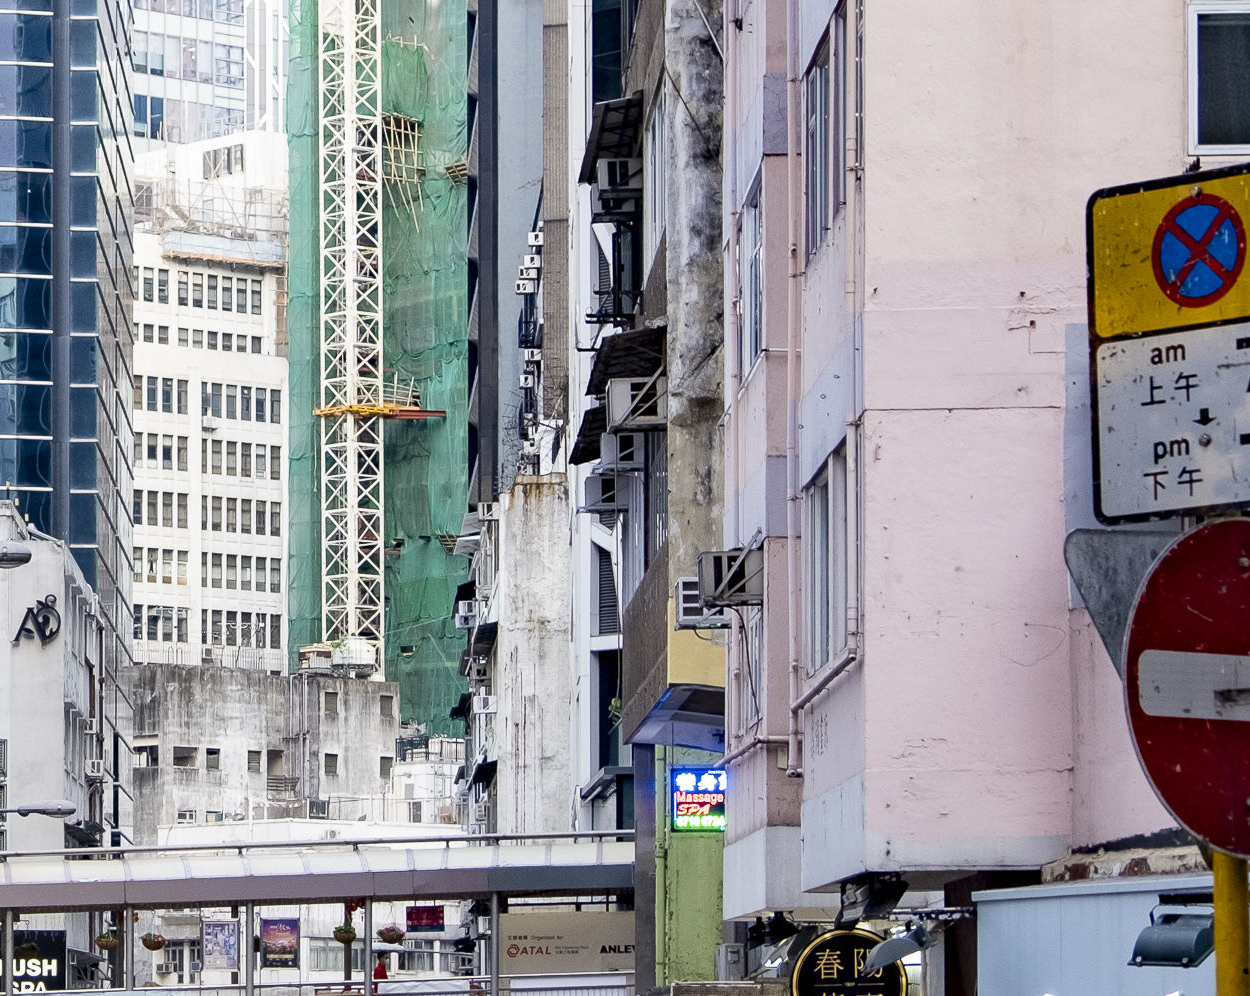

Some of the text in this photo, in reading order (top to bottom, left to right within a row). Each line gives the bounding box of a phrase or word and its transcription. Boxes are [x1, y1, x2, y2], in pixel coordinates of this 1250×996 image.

[1150, 343, 1186, 365] am
[1141, 372, 1199, 406] 上午
[1153, 438, 1190, 465] pm
[1143, 467, 1203, 501] 下午
[676, 791, 724, 806] Massage
[677, 803, 711, 816] SPA
[519, 945, 552, 956] ATAL
